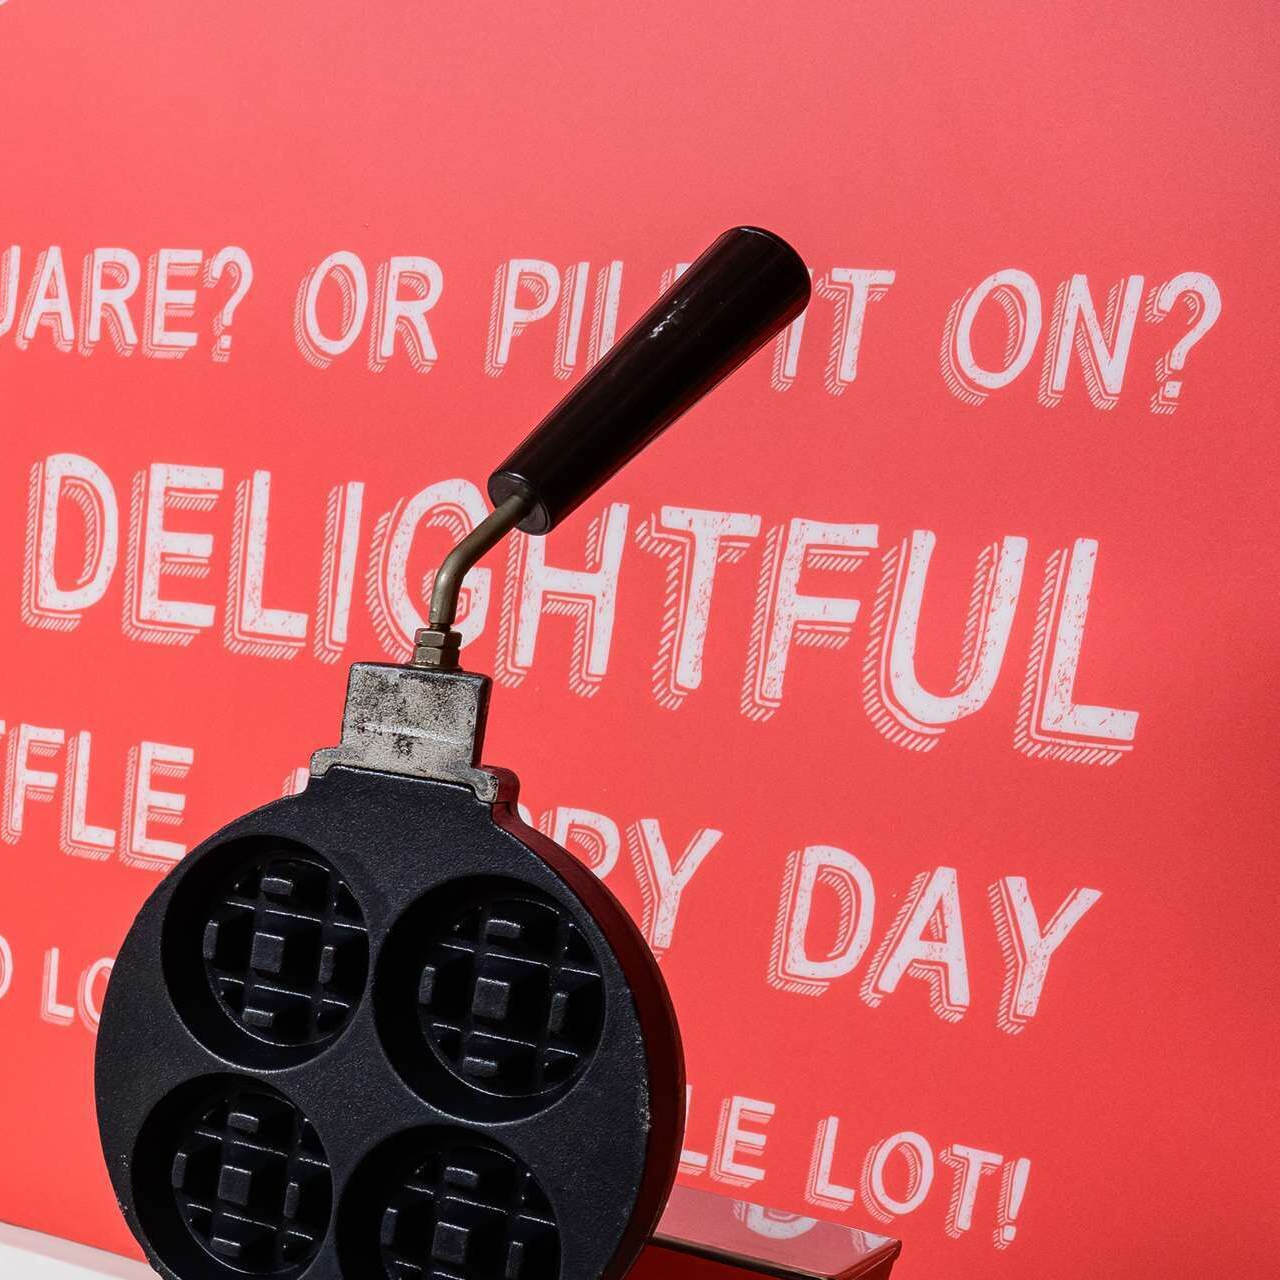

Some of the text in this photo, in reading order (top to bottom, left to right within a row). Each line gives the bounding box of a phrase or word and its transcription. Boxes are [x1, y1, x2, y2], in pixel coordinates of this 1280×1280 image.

[293, 250, 444, 374] OR
[484, 258, 692, 380] PIL
[940, 268, 1222, 414] ON?
[21, 452, 1140, 766] DELIGHTFUL
[766, 844, 1104, 1035] DAY
[804, 1116, 1031, 1250] LOT!
